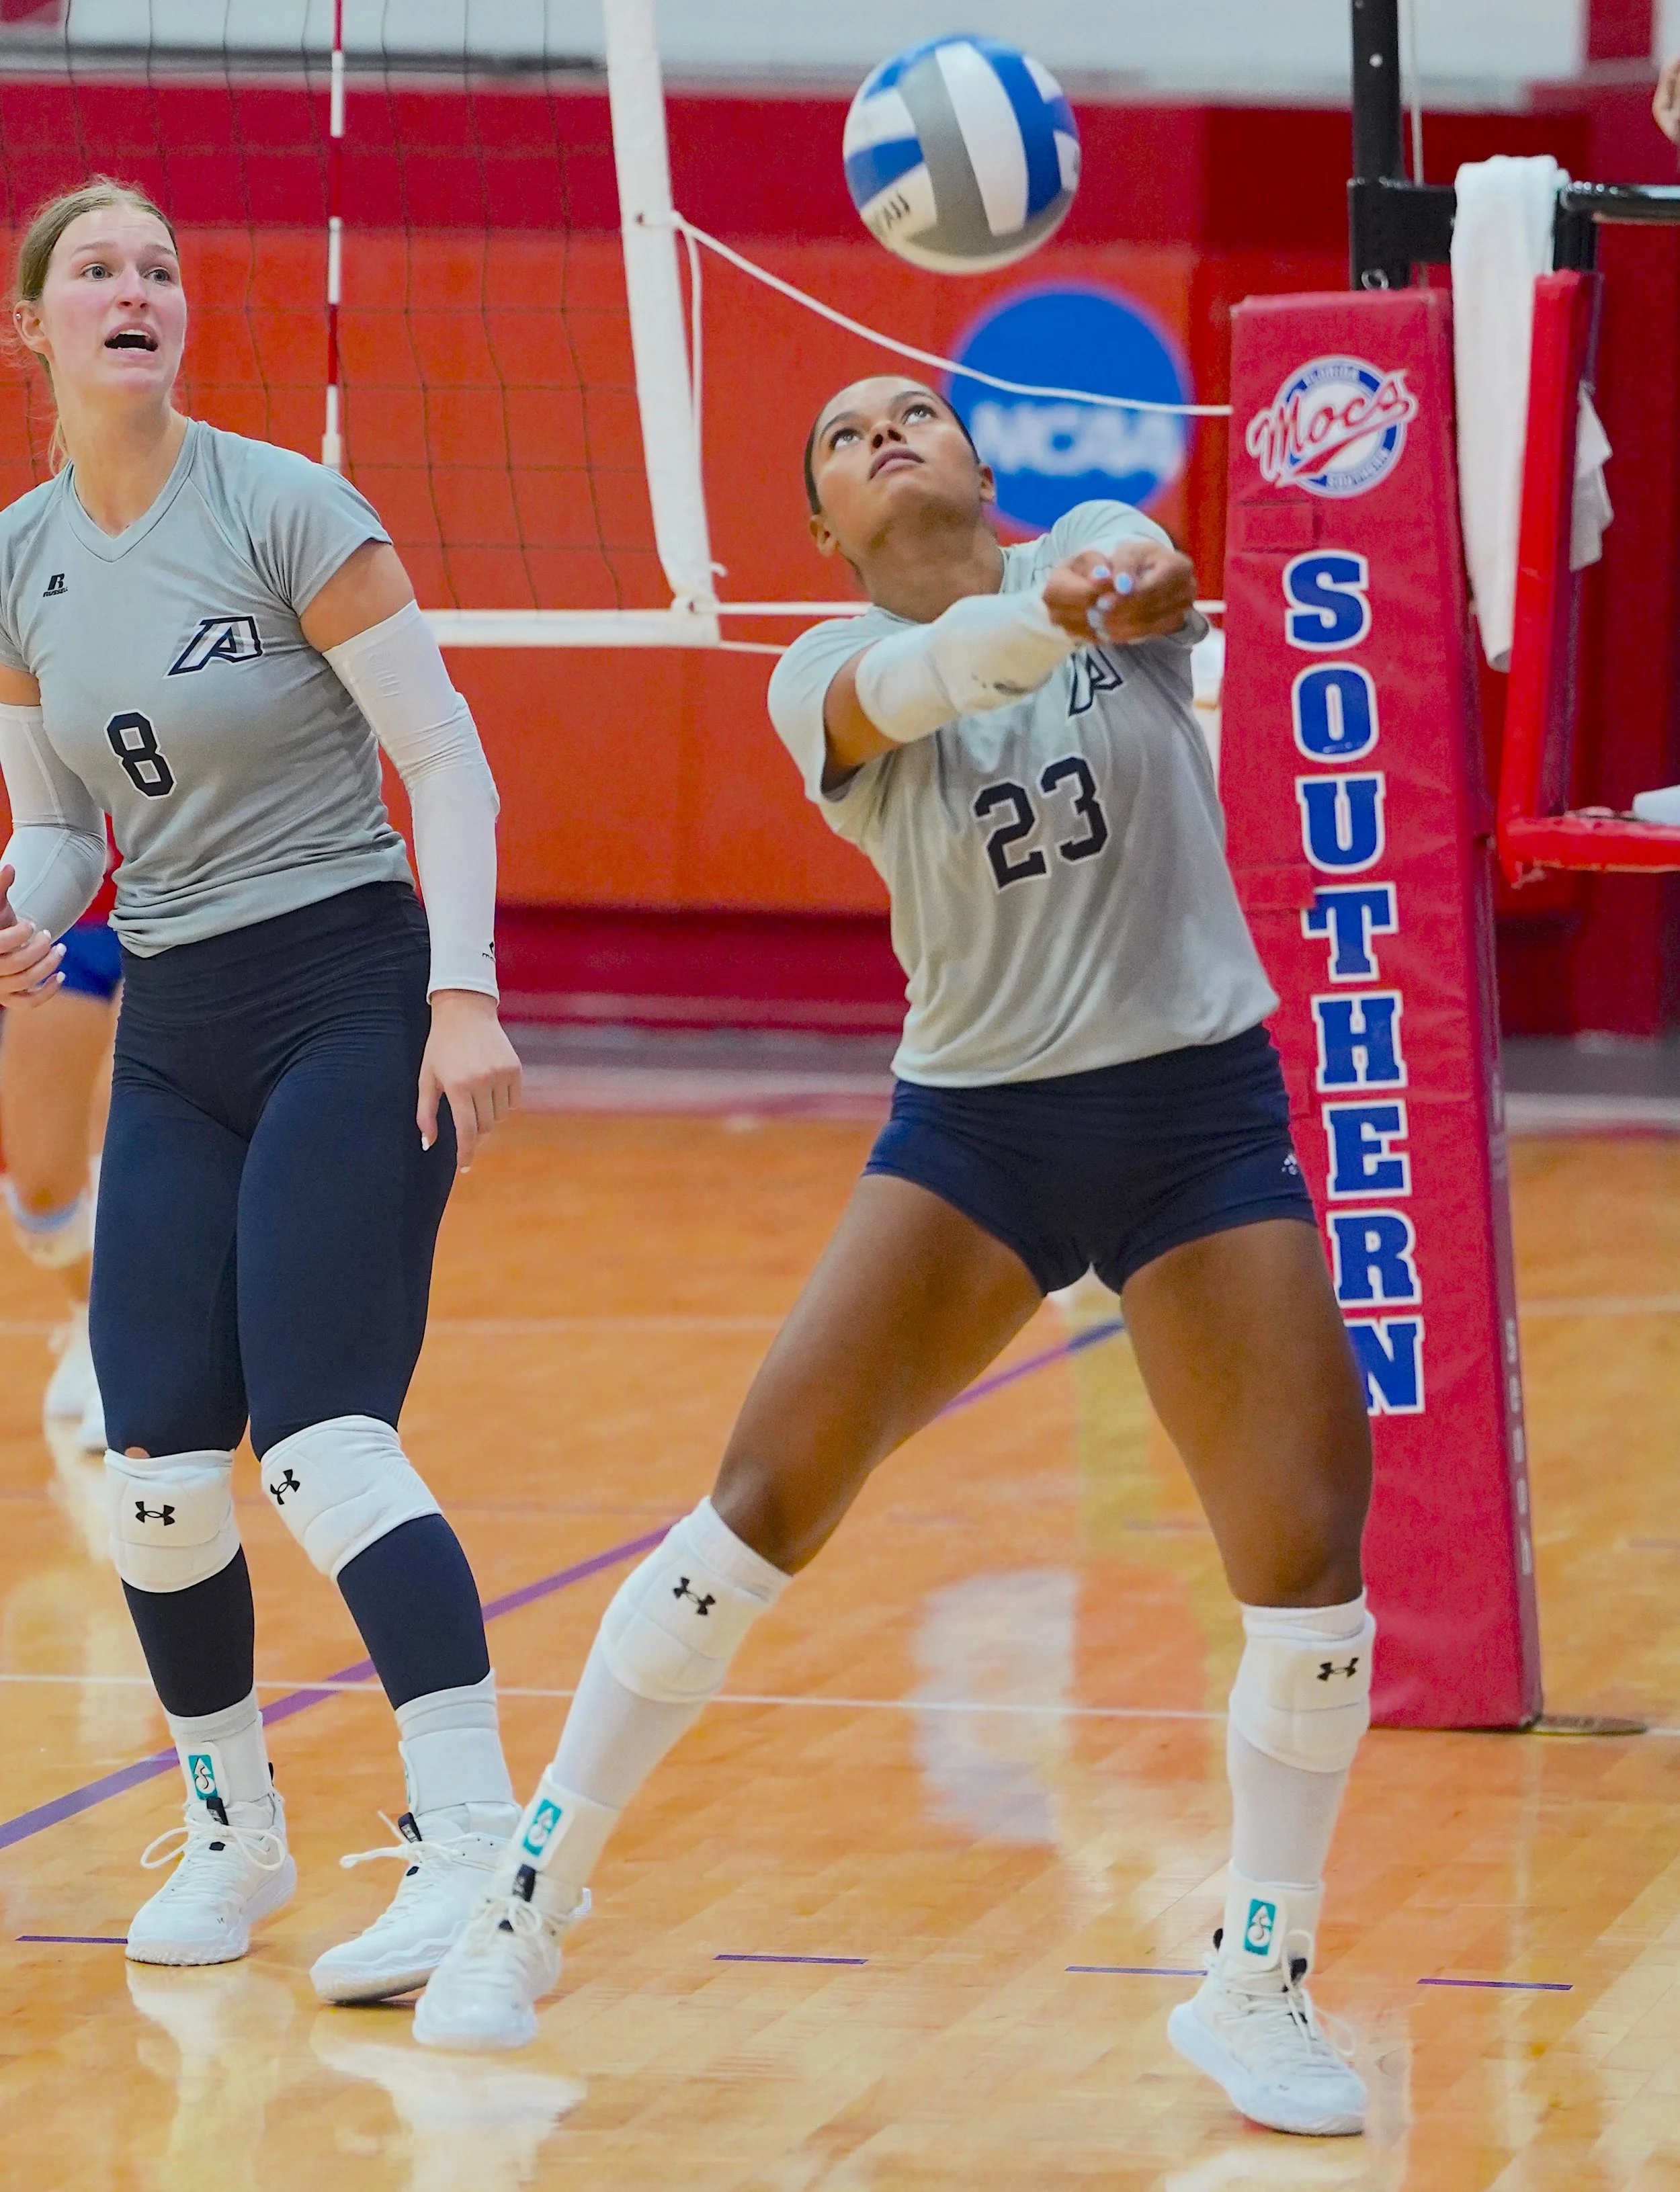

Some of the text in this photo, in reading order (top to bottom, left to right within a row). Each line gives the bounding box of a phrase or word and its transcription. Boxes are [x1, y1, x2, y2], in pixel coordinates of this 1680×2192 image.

[972, 402, 1180, 481] NCAA
[1247, 370, 1417, 485] Mocs
[104, 709, 177, 800] 8
[972, 754, 1112, 893] 23
[1283, 549, 1425, 1416] SOUTHERN
